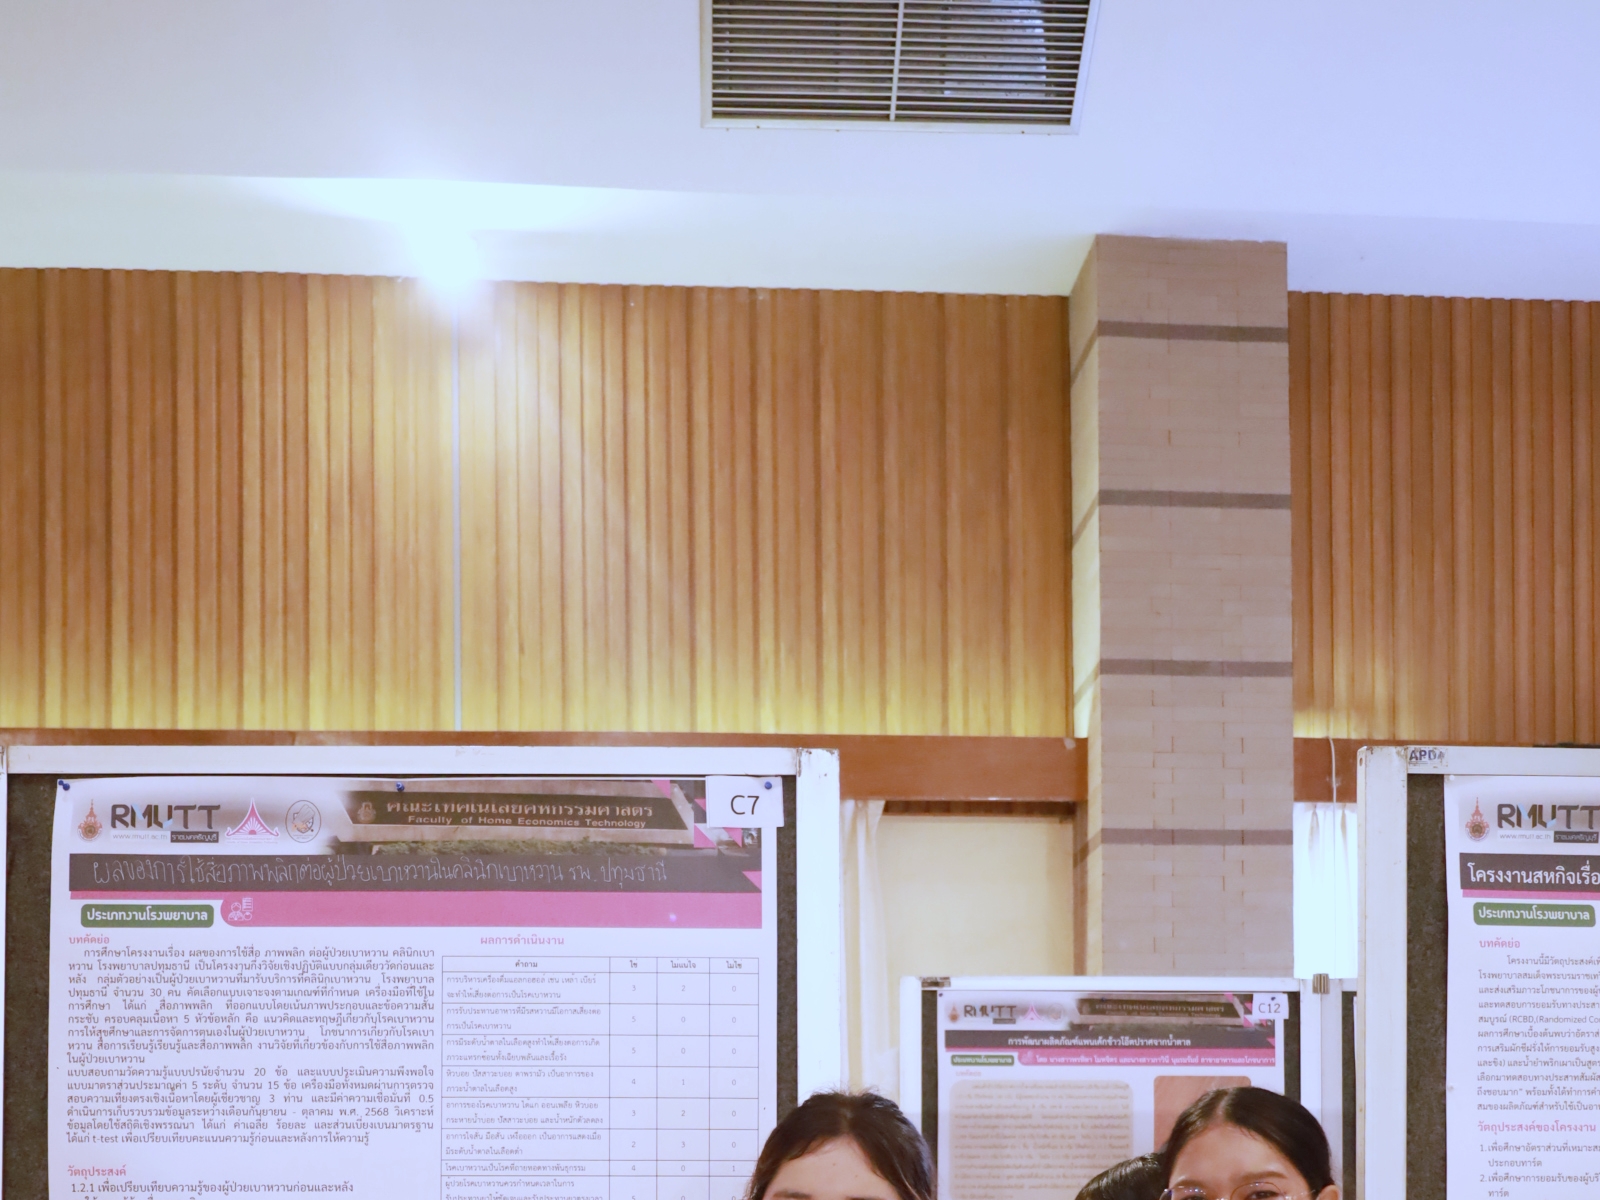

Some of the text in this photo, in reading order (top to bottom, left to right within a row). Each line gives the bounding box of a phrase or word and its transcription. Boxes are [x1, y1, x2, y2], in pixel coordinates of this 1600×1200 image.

[730, 795, 760, 815] C7
[111, 804, 221, 829] RMUTT
[408, 815, 646, 828] Faculty of Home Economics Technology
[1497, 803, 1600, 829] RMUTT
[568, 864, 597, 882] รพ.
[601, 857, 668, 888] ปทุมธานี
[87, 908, 209, 923] ประเภทงานโรงพยาบาล
[1478, 905, 1590, 921] ประเภทงานโรงพยาบาล
[68, 932, 110, 945] บทคัดย่อ
[1478, 936, 1521, 949] บทคัดย่อ
[263, 946, 306, 958] ภาพพลิก
[1258, 1003, 1281, 1014] C12
[67, 1012, 100, 1024] กระชับ
[183, 1014, 191, 1024] 5
[244, 1012, 259, 1024] คือ
[66, 1131, 91, 1143] ได้แก่
[92, 1133, 119, 1143] t-test
[66, 1165, 127, 1181] วัตถุประสงค์
[70, 1183, 95, 1193] 1.2.1
[1487, 1186, 1510, 1198] ทาร์ต
